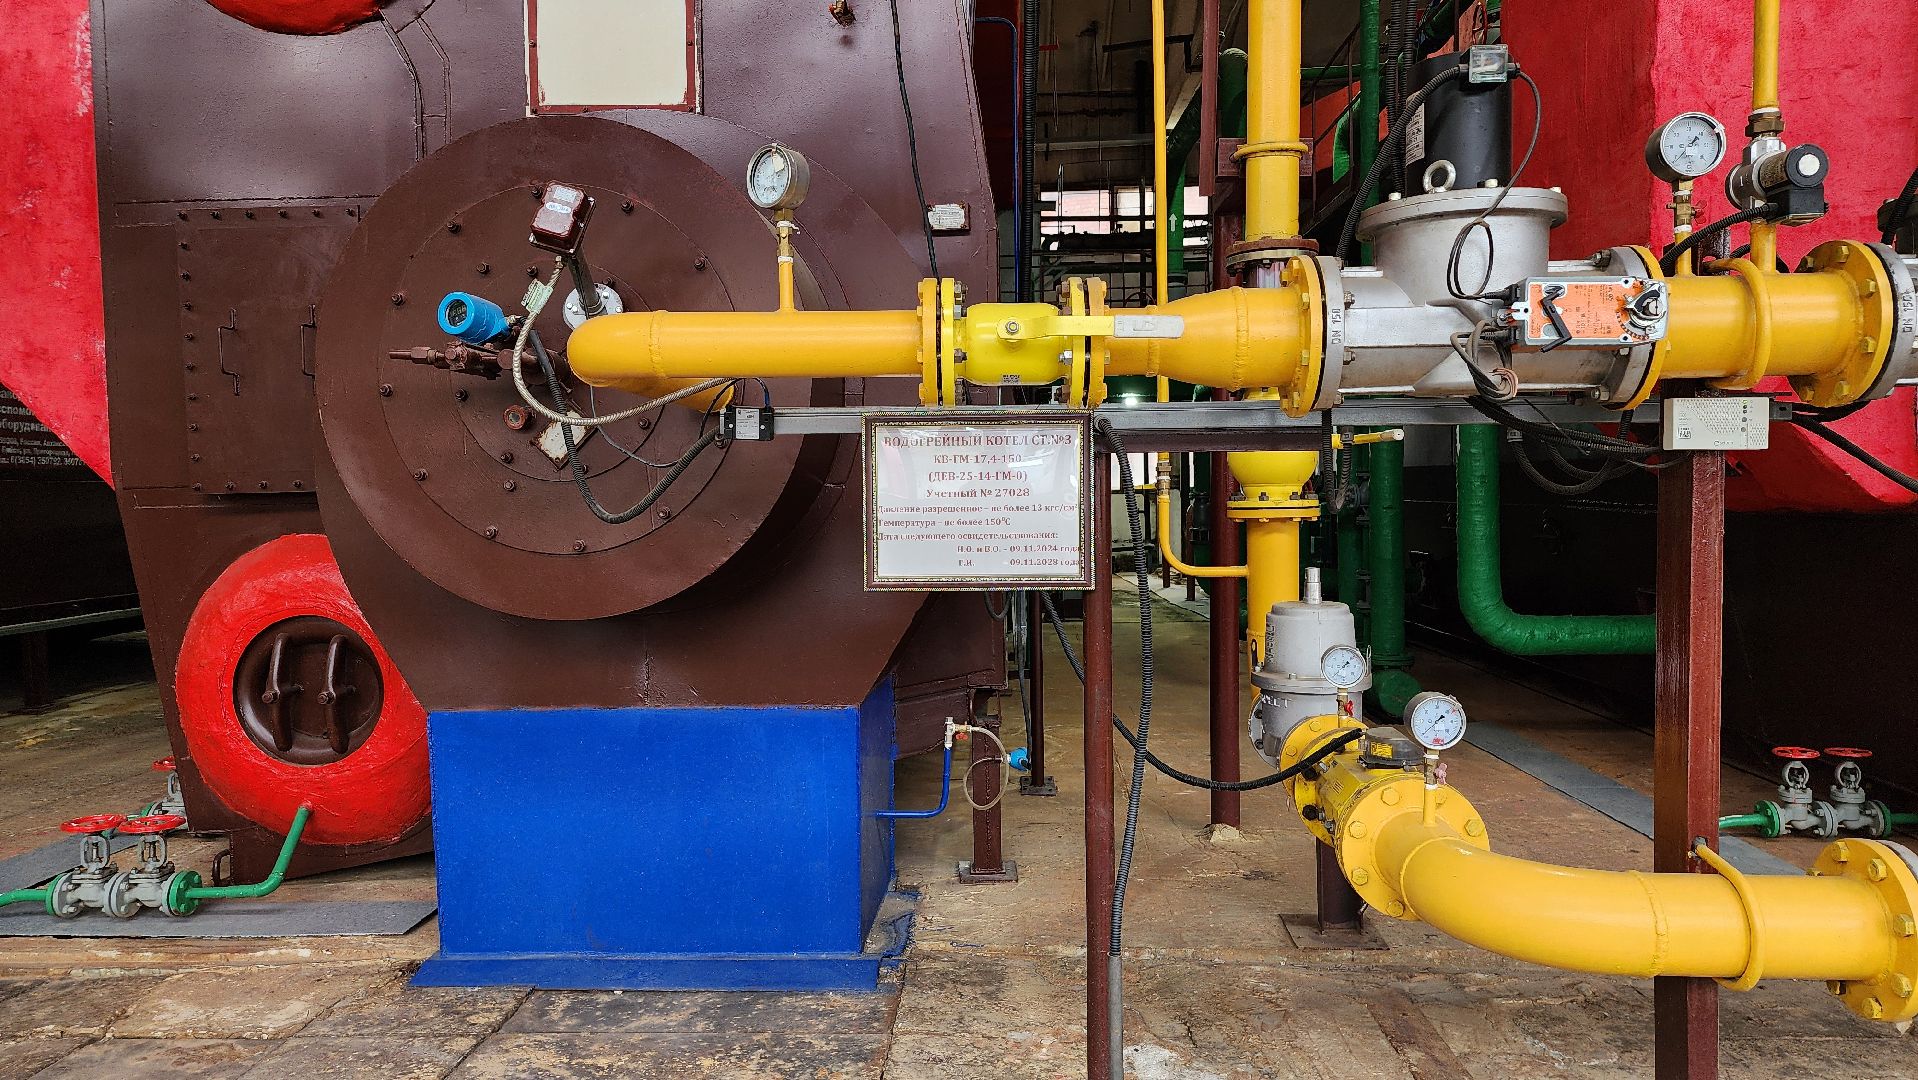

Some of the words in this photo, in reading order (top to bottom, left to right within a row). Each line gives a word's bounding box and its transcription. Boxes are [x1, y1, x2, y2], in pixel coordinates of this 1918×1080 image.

[1331, 308, 1341, 325] 150
[1331, 330, 1341, 345] DN
[0, 405, 35, 416] спомо
[0, 418, 51, 433] борудова
[884, 433, 982, 448] ВОДОГРЕЙНЫЙ
[986, 435, 1029, 446] КОТЕЛ
[934, 454, 1022, 465] КВ-ГМ-17,4-150
[926, 488, 978, 498] Учетный
[994, 487, 1030, 497] 27028
[1003, 503, 1030, 512] более
[1032, 504, 1043, 512] 13
[956, 518, 983, 526] более
[1009, 544, 1059, 553] 09.11.2024
[1009, 558, 1059, 566] 09.11.2028
